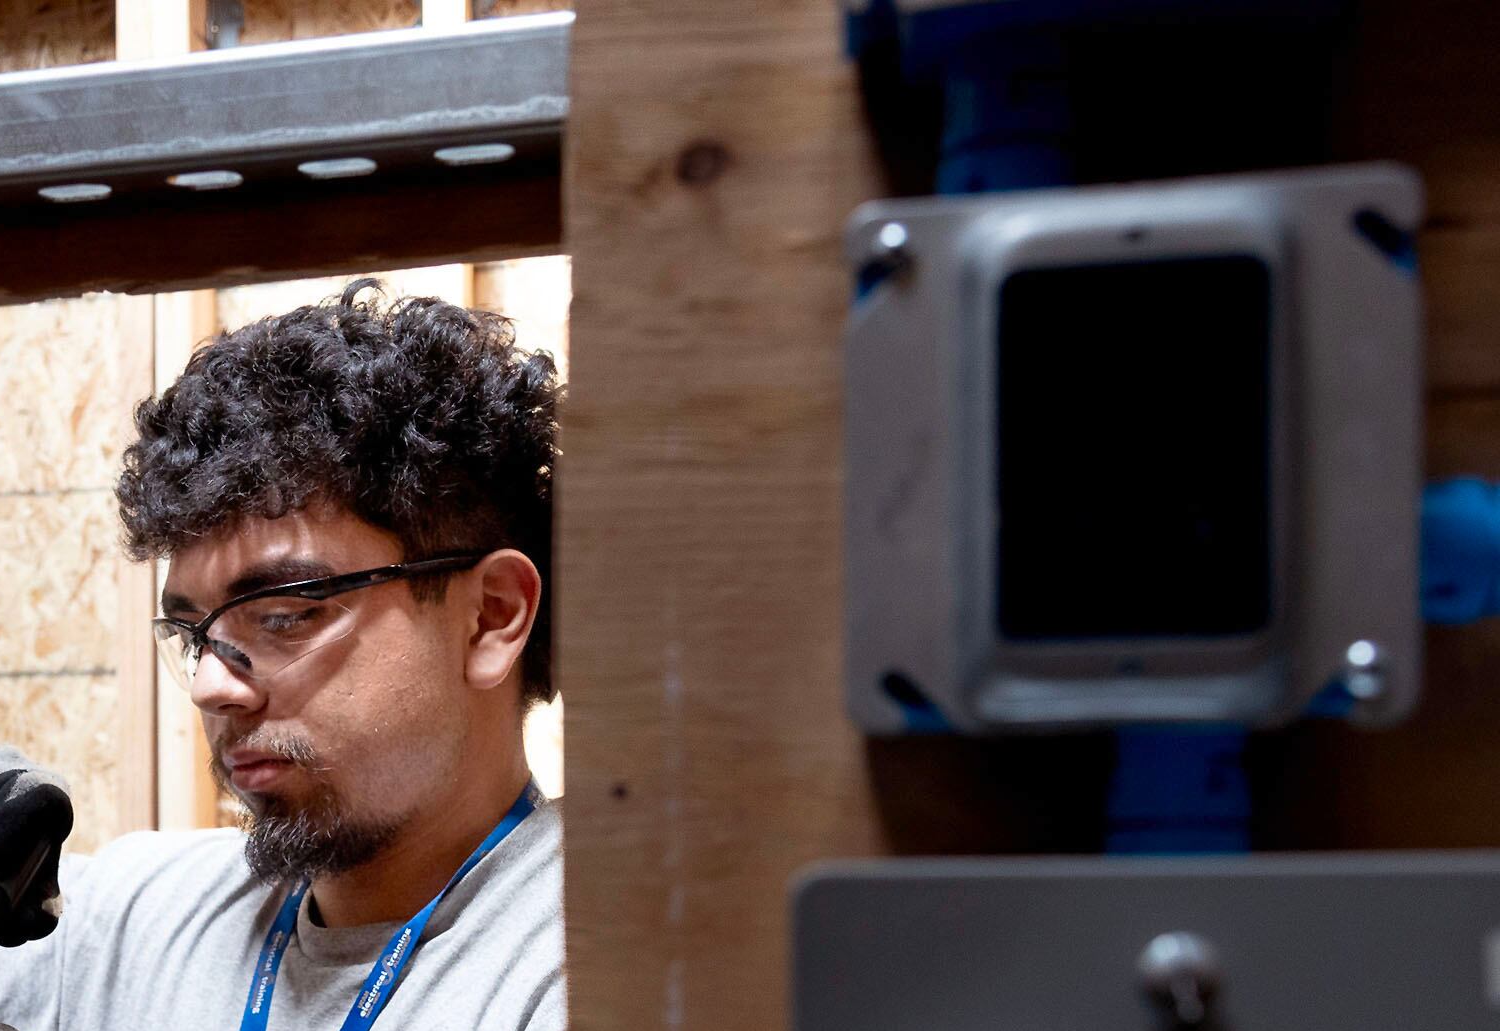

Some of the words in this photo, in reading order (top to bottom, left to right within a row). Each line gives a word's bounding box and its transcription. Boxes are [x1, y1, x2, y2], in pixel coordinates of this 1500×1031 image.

[251, 976, 269, 1014] training
[360, 970, 388, 1018] electrical
[386, 927, 412, 967] training
